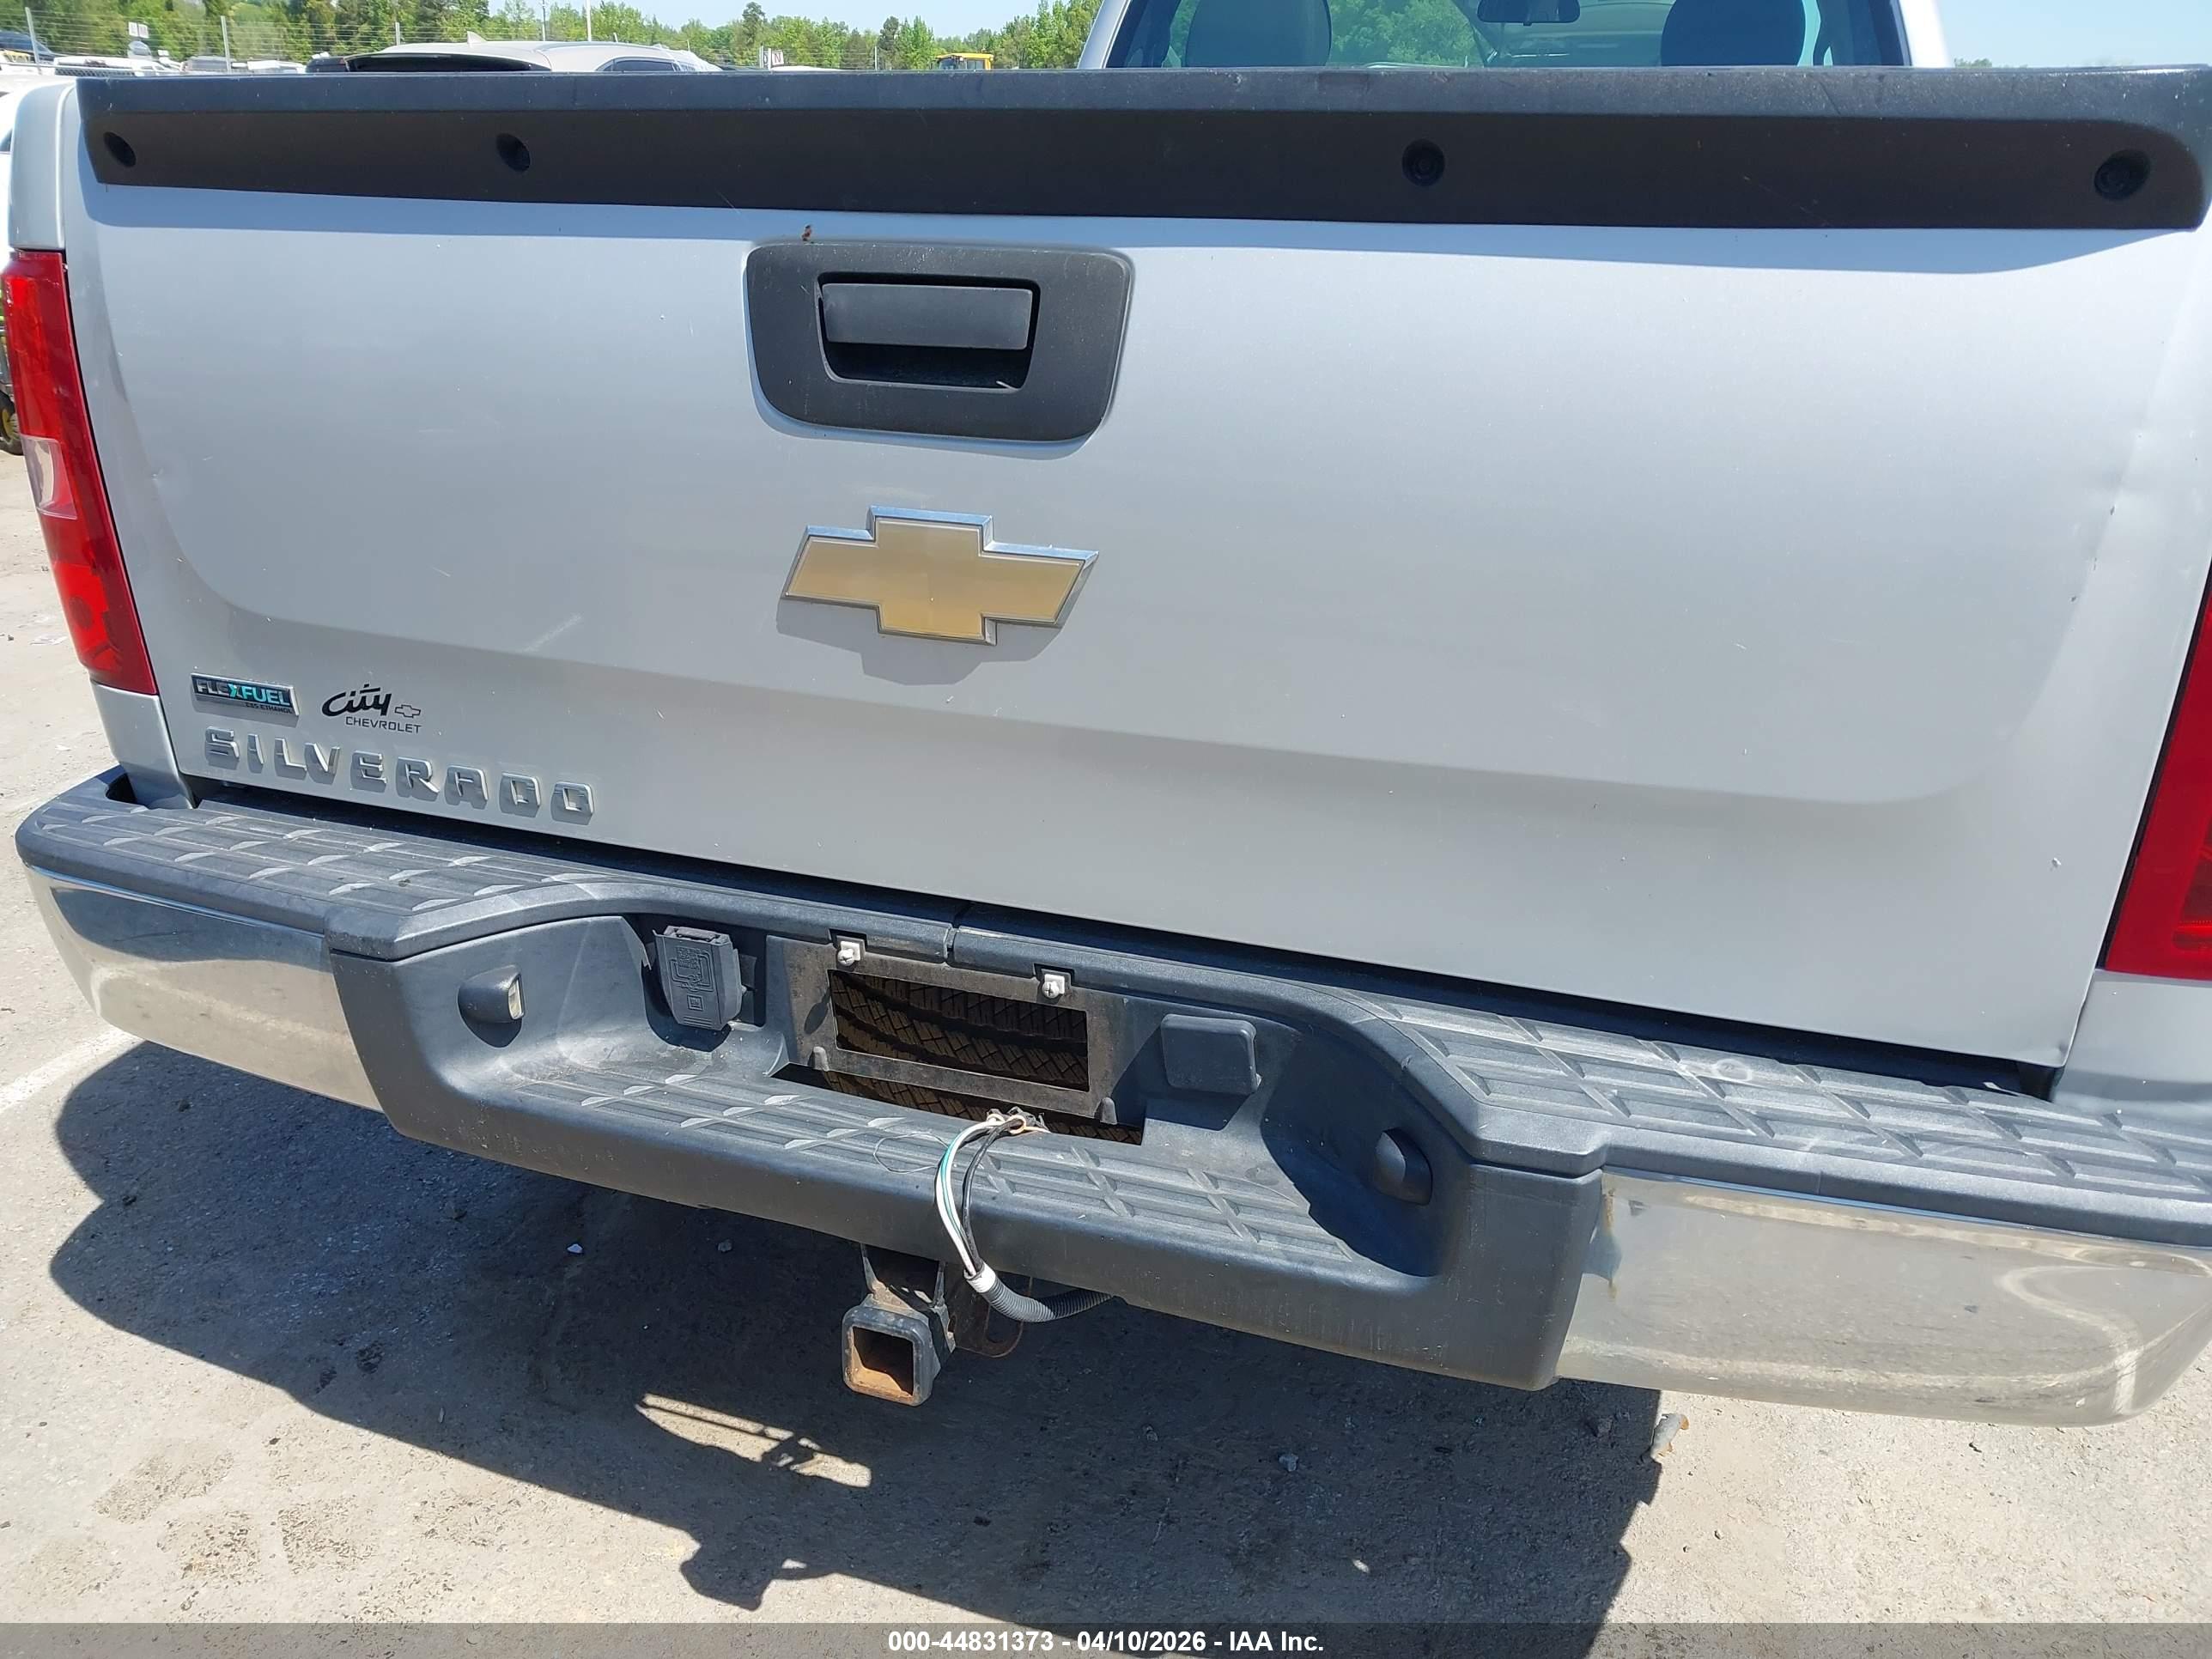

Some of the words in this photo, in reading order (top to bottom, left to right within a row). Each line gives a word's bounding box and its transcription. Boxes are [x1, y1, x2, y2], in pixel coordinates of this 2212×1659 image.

[196, 678, 290, 706] FLEXFUEL
[345, 716, 422, 734] CHEVROLET
[204, 726, 596, 817] SILVERADO
